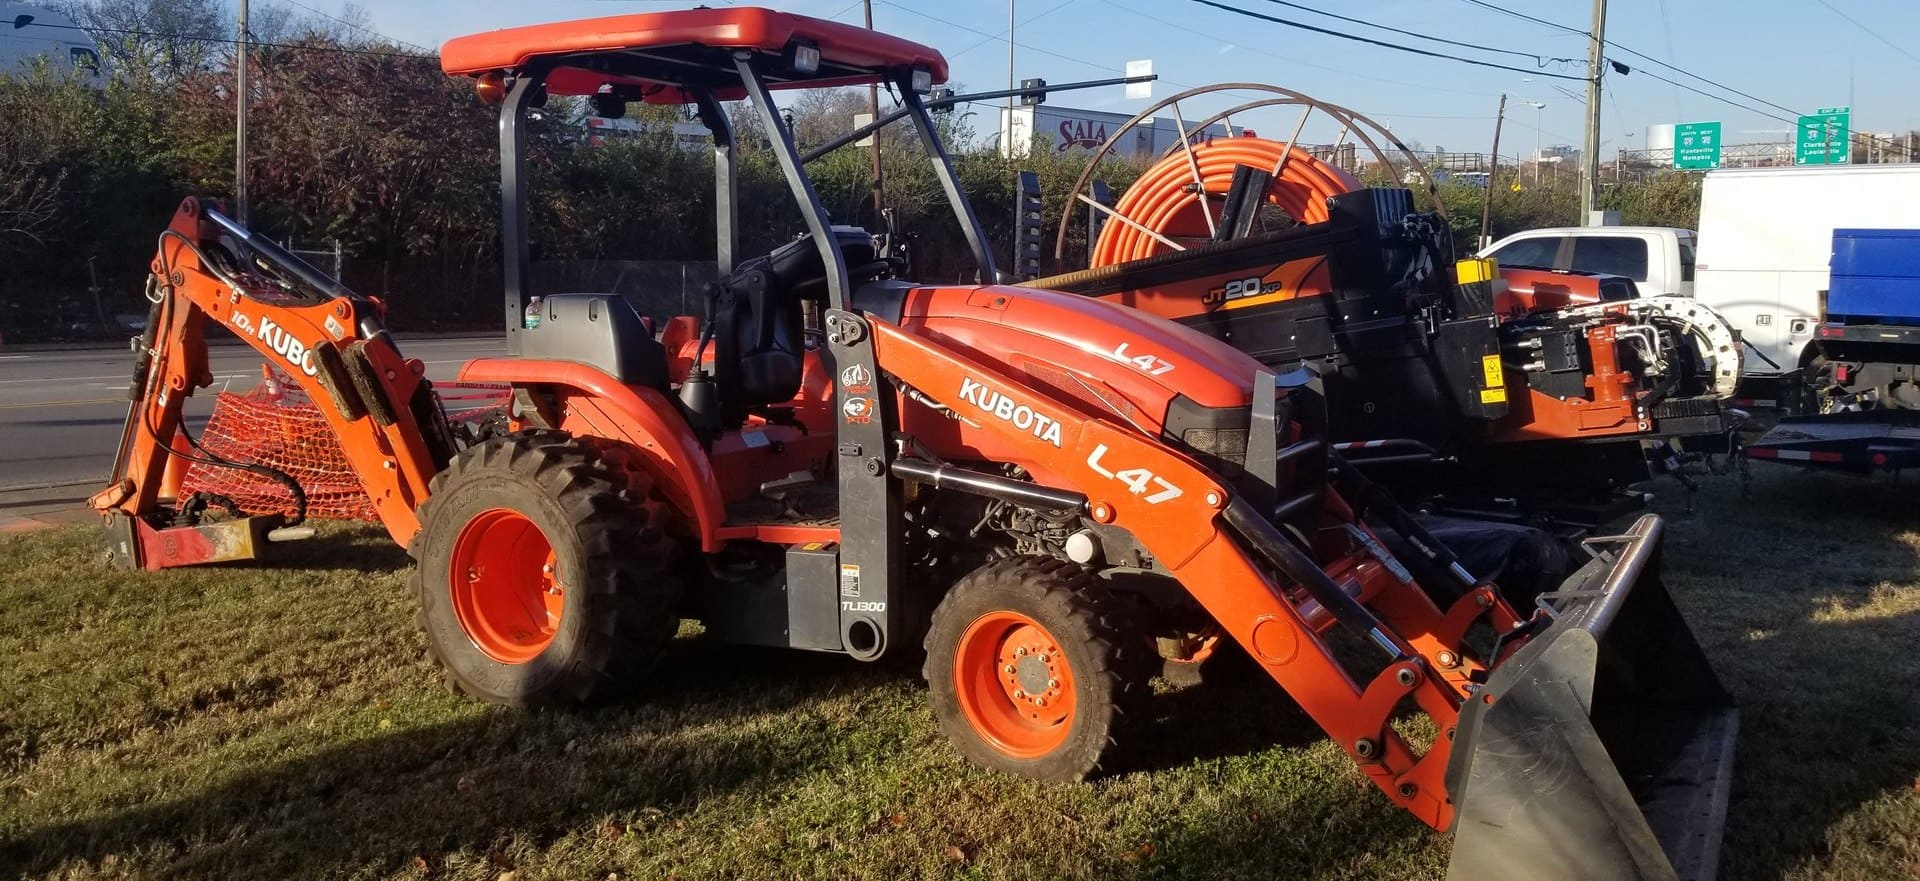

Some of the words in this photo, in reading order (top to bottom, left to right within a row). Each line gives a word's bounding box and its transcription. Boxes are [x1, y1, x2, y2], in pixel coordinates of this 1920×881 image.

[1059, 119, 1108, 148] SAIA
[257, 315, 324, 385] KUBO
[1112, 342, 1176, 376] L47
[958, 376, 1062, 448] KUBOTA
[1086, 443, 1184, 505] L47
[841, 601, 886, 612] TL1300
